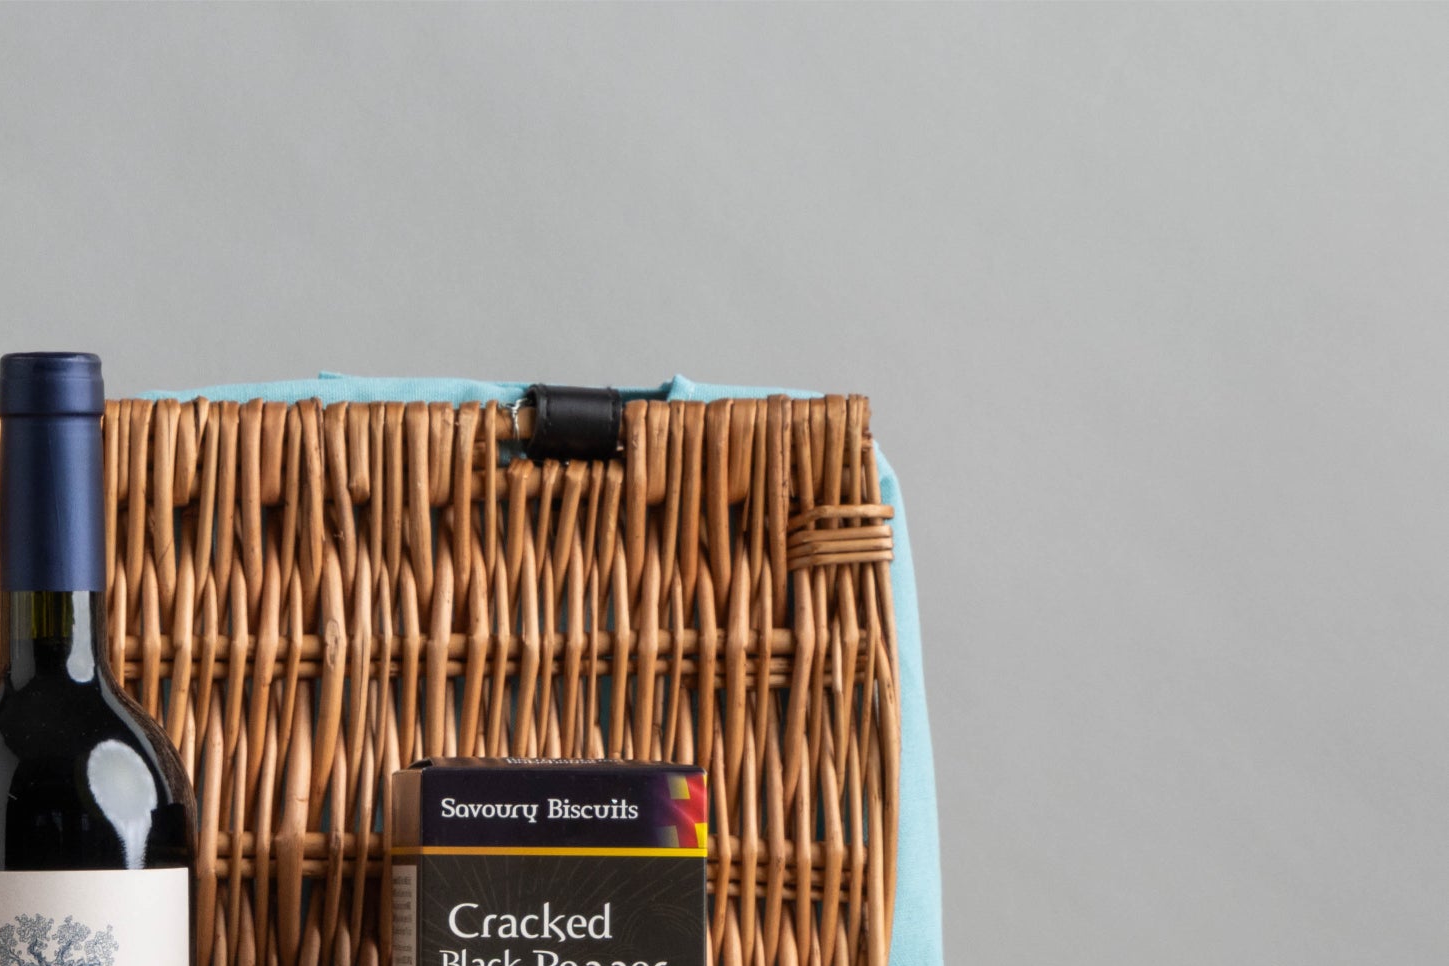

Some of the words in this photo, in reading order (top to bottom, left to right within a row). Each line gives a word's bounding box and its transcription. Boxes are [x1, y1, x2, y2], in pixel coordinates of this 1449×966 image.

[441, 798, 539, 823] Savoury
[547, 799, 639, 820] Biscuits
[448, 902, 613, 942] Cracked
